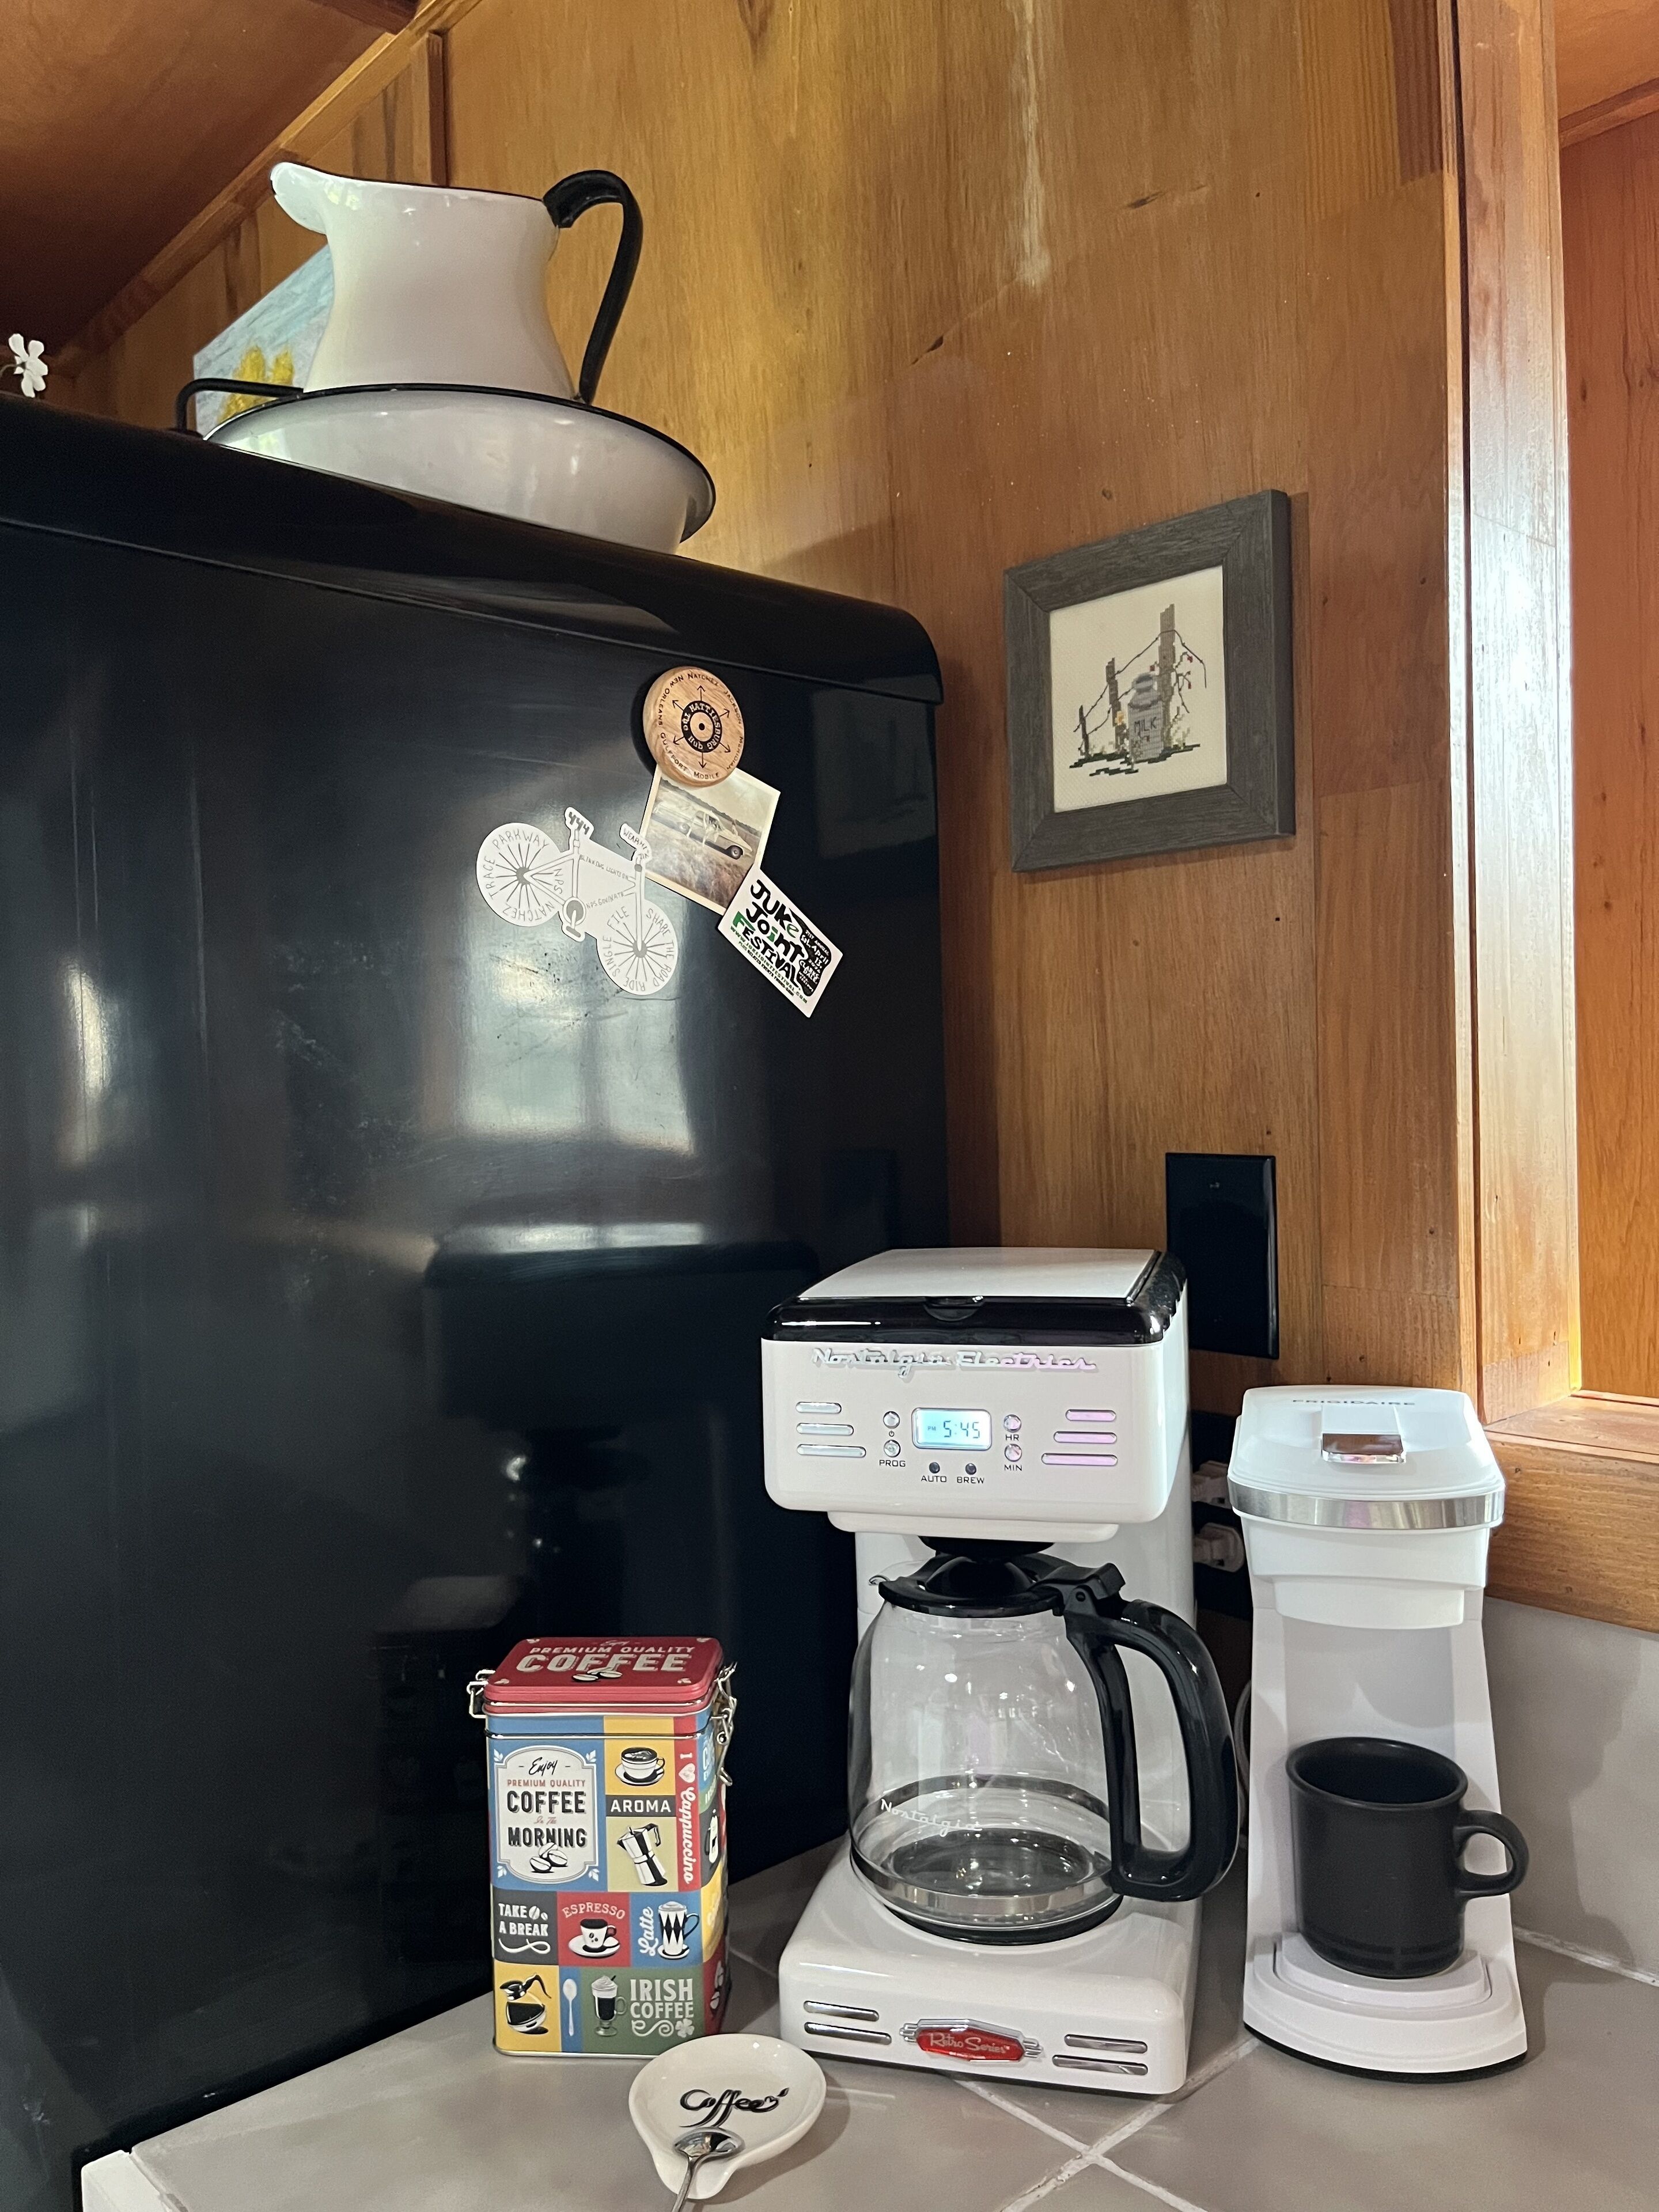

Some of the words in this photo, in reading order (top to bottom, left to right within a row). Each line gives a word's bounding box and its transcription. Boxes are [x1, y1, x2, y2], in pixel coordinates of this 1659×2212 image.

[670, 675, 684, 687] NEW
[658, 688, 670, 726] ORLEANS
[723, 691, 742, 725] JACKSON
[689, 702, 721, 749] HATTIESBURG
[1134, 717, 1157, 734] MILK
[661, 732, 688, 771] GULFPORT
[694, 771, 719, 779] MOBILE
[492, 828, 550, 850] PARKWAY
[483, 855, 496, 900] TRACE
[553, 868, 565, 894] NPS
[502, 900, 555, 922] NATCHEZ
[607, 906, 630, 930] FILE
[646, 908, 671, 937] SHARE
[603, 935, 620, 978] SINGLE
[665, 940, 675, 960] THE
[732, 911, 799, 988] FESTIVAL
[623, 976, 646, 992] RIDE
[653, 964, 672, 987] ROAD
[811, 1347, 952, 1379] Nostalgia
[956, 1349, 1097, 1370] Electrics
[943, 1420, 980, 1439] 5:45
[1005, 1434, 1020, 1442] HR
[878, 1459, 907, 1468] PROG
[1004, 1464, 1023, 1472] MIN
[921, 1475, 948, 1483] AUTO
[956, 1476, 985, 1484] BREW
[529, 1646, 612, 1654] PREMIUM
[619, 1646, 696, 1654] QUALITY
[516, 1653, 694, 1672] COFFEE
[528, 1756, 558, 1777] Enjoy
[507, 1779, 546, 1787] PREMIUM
[550, 1779, 586, 1788] QUALITY
[507, 1790, 587, 1815] COFFEE
[610, 1798, 672, 1814] AROMA
[880, 1798, 983, 1838] Nostalgia
[507, 1827, 588, 1848] MORNING
[678, 1786, 697, 1885] Cappuccino
[498, 1903, 528, 1918] TAKE
[561, 1901, 626, 1920] ESPRESSO
[499, 1922, 508, 1934] A
[509, 1922, 549, 1936] BREAK
[639, 1906, 660, 1957] Latte
[630, 1978, 694, 2002] IRISH
[630, 2001, 694, 2018] COFFEE
[929, 2032, 964, 2048] Retro
[680, 2088, 781, 2128] Coffee
